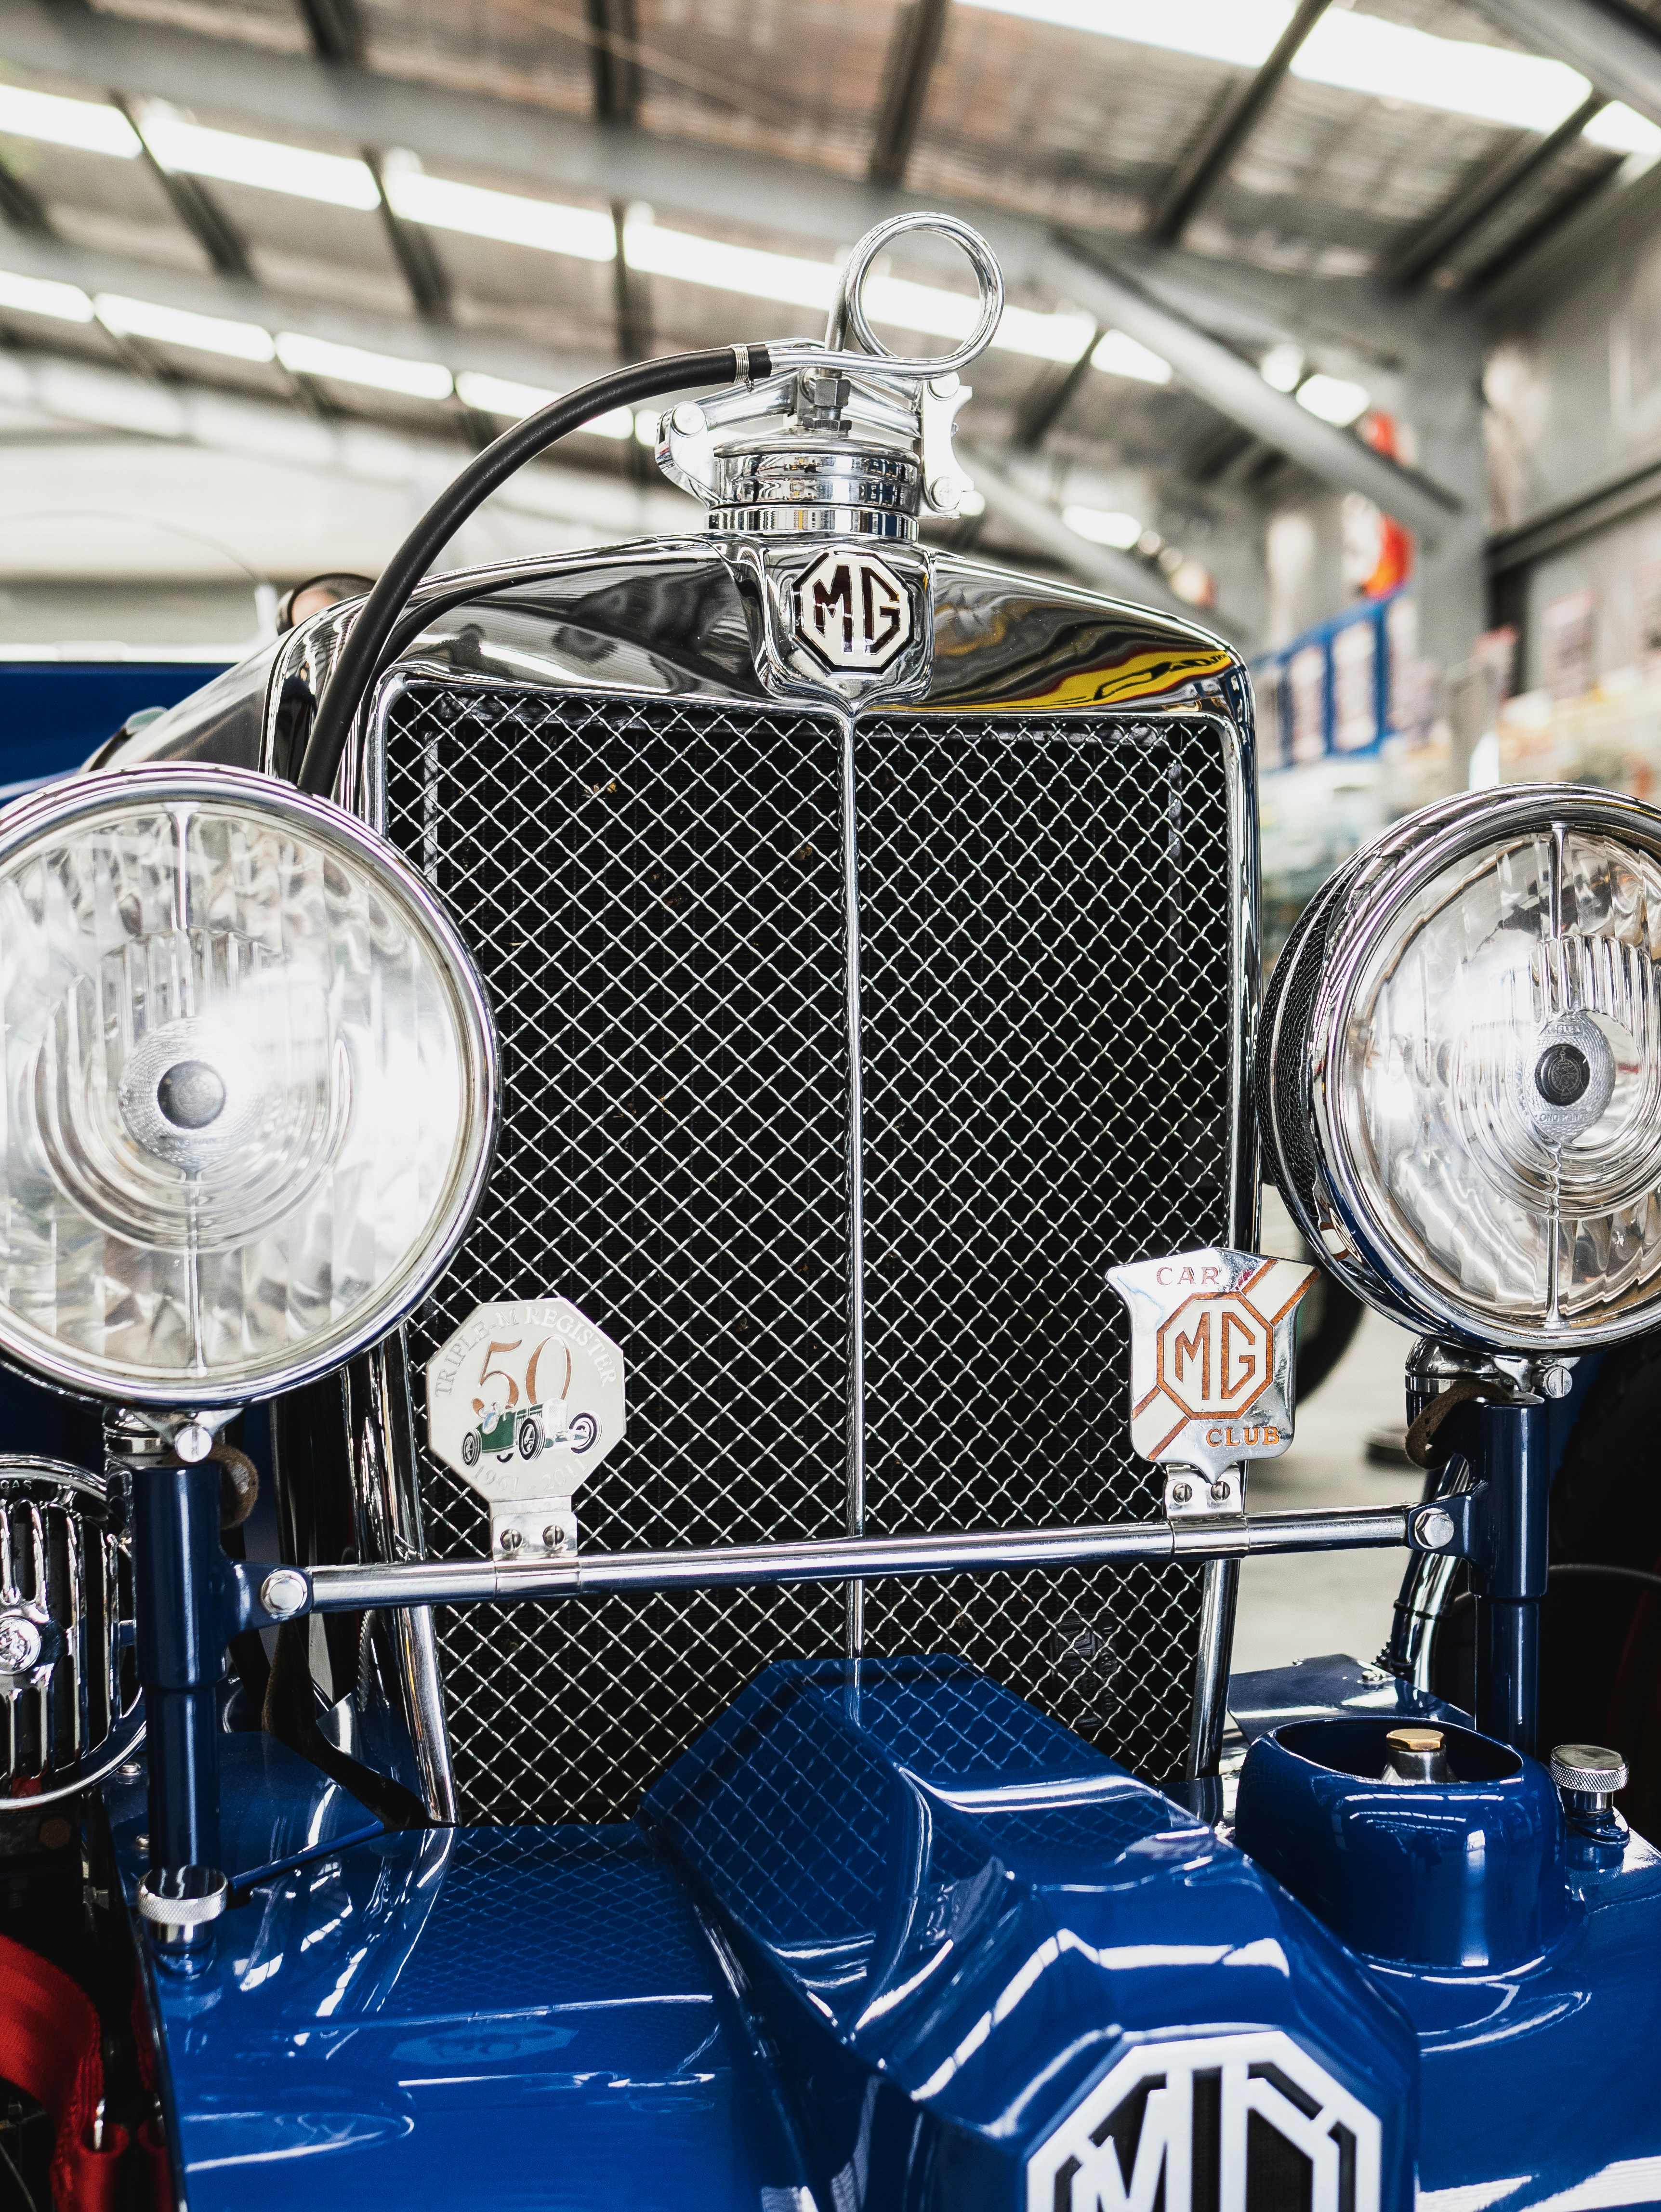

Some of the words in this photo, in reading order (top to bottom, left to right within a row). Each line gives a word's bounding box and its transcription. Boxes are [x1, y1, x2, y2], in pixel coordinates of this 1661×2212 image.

[812, 564, 900, 655] MG
[1156, 1266, 1220, 1286] CAR
[435, 1308, 520, 1397] TRIPLE-M
[524, 1306, 617, 1388] REGISTER
[471, 1333, 572, 1418] 50
[1175, 1311, 1256, 1400] MG
[472, 1465, 520, 1493] 1961
[541, 1456, 589, 1491] 2011
[1205, 1426, 1280, 1447] CLUB
